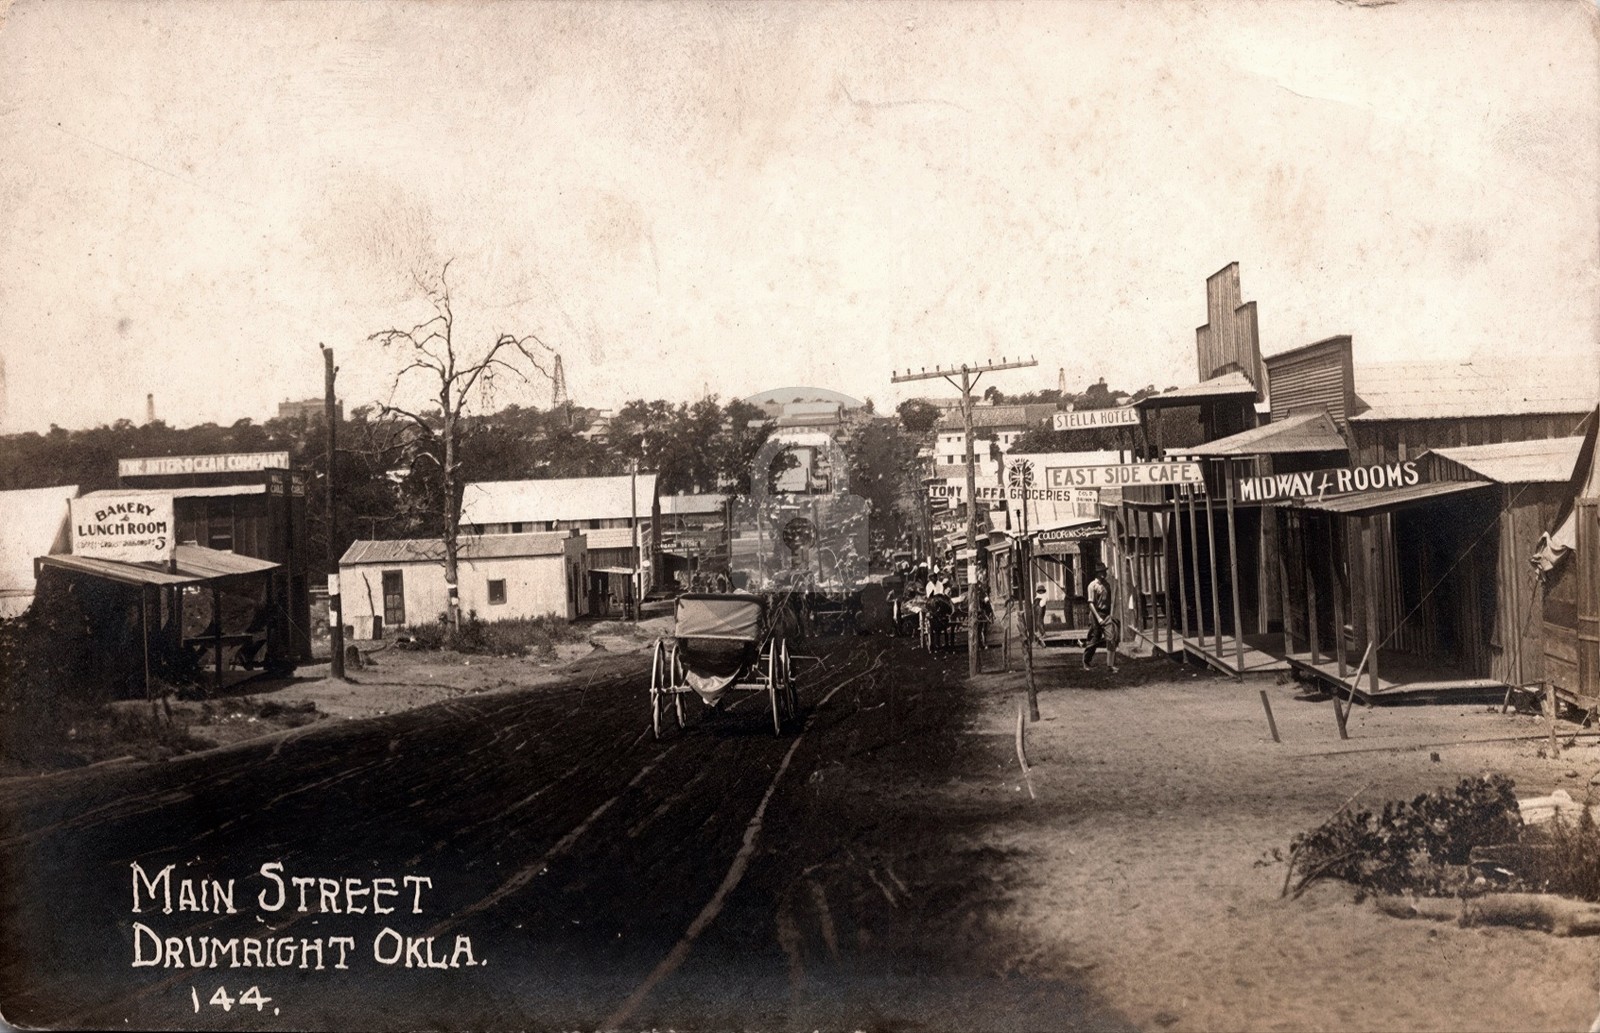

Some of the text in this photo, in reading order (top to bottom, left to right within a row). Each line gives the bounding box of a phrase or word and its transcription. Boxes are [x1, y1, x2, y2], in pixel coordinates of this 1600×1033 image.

[1056, 409, 1136, 428] STELLA HOTEL
[227, 454, 285, 471] COMPANY
[1052, 467, 1098, 487] EAST
[1104, 465, 1141, 484] SIDE
[1240, 471, 1315, 502] MIDWAY
[1336, 461, 1420, 493] ROOMS
[931, 485, 963, 497] TONY
[1010, 488, 1071, 502] GROCERIES
[94, 502, 156, 522] BAKERY
[78, 521, 168, 537] LUNCH ROOM
